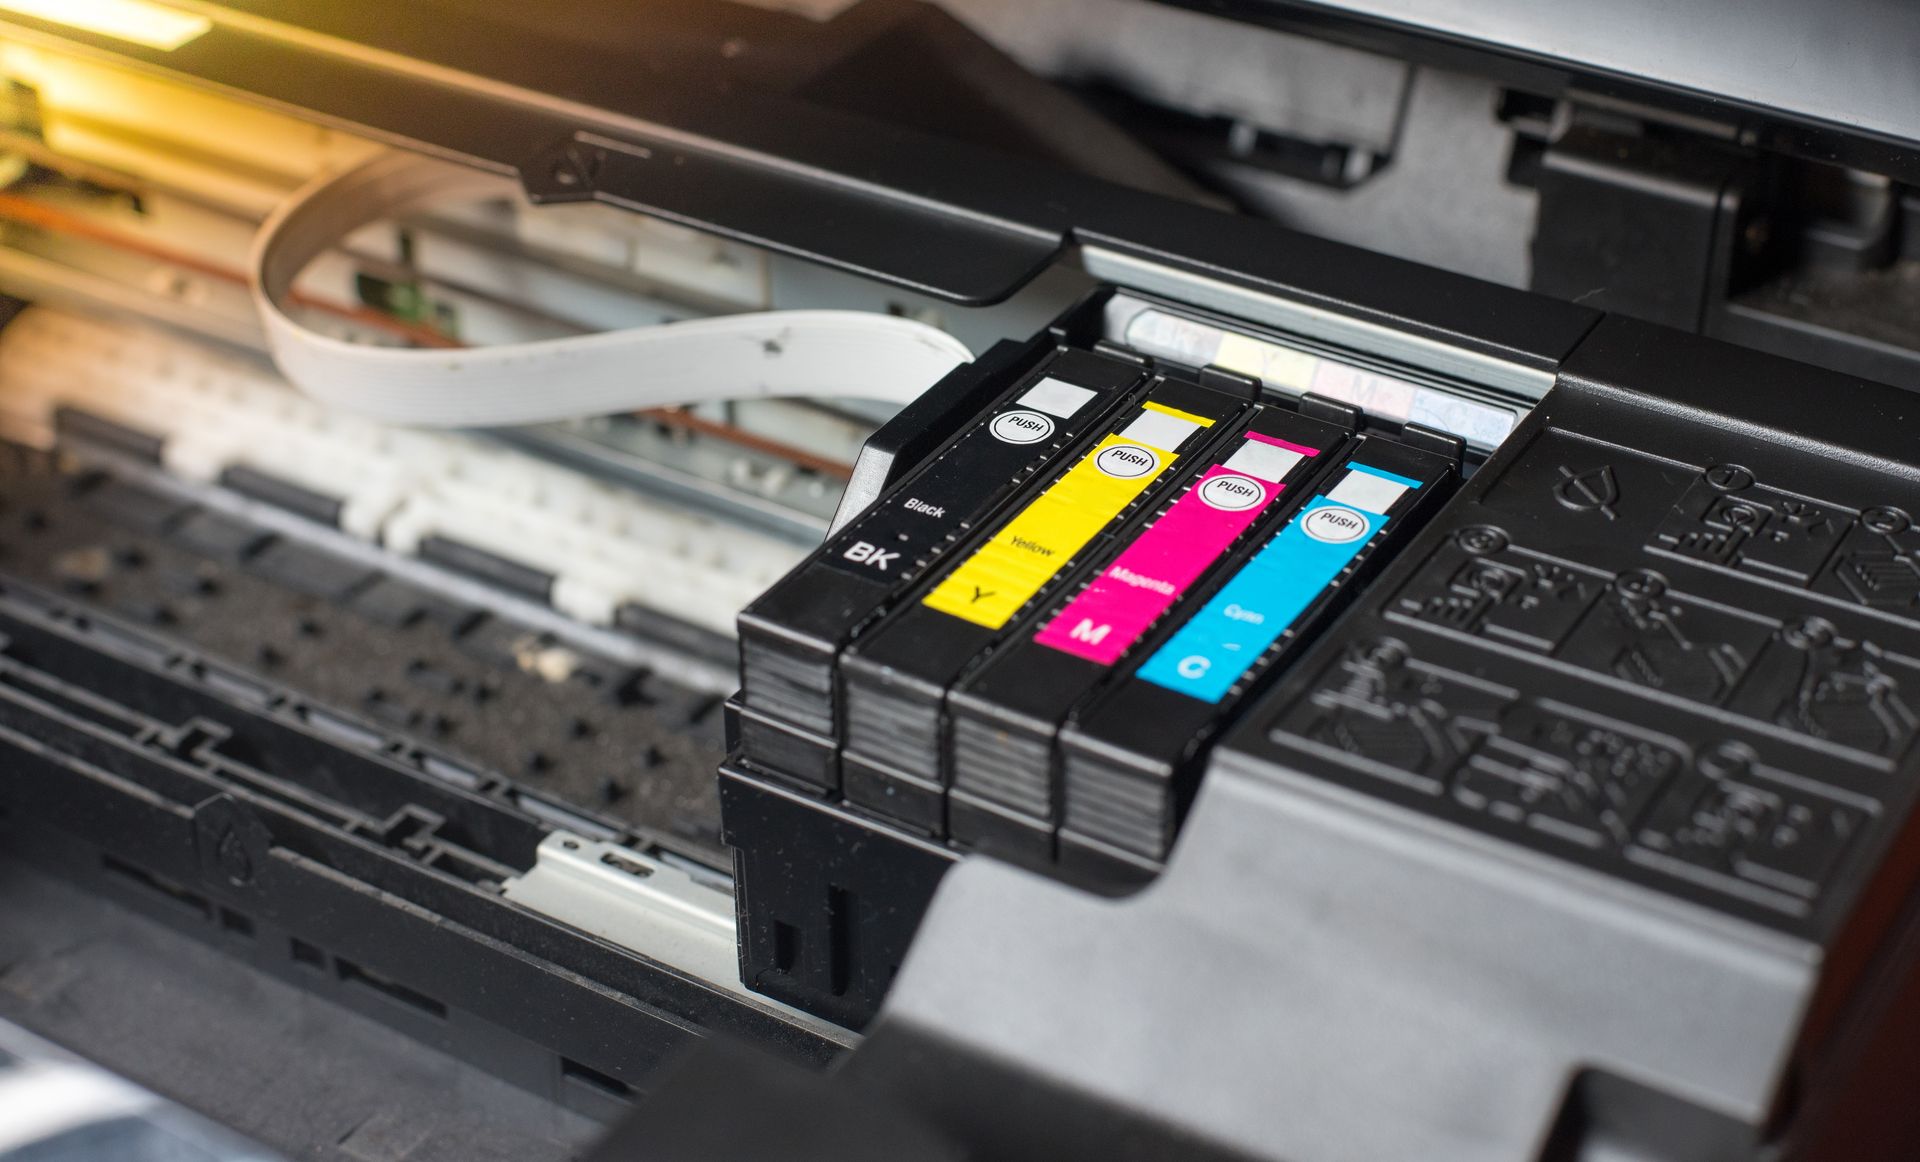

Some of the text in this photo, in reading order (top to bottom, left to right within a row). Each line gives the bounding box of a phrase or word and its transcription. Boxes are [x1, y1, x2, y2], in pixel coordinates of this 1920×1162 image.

[1350, 374, 1377, 405] M
[1007, 415, 1044, 433] PUSH
[1112, 449, 1149, 467] PUSH
[1216, 479, 1255, 498] PUSH
[903, 498, 946, 519] Black
[1319, 512, 1358, 530] PUSH
[843, 540, 901, 570] BK
[1010, 535, 1056, 557] Yellow
[1108, 565, 1176, 596] Magenta
[970, 585, 996, 604] Y
[1069, 618, 1112, 646] M
[1177, 654, 1212, 679] C
